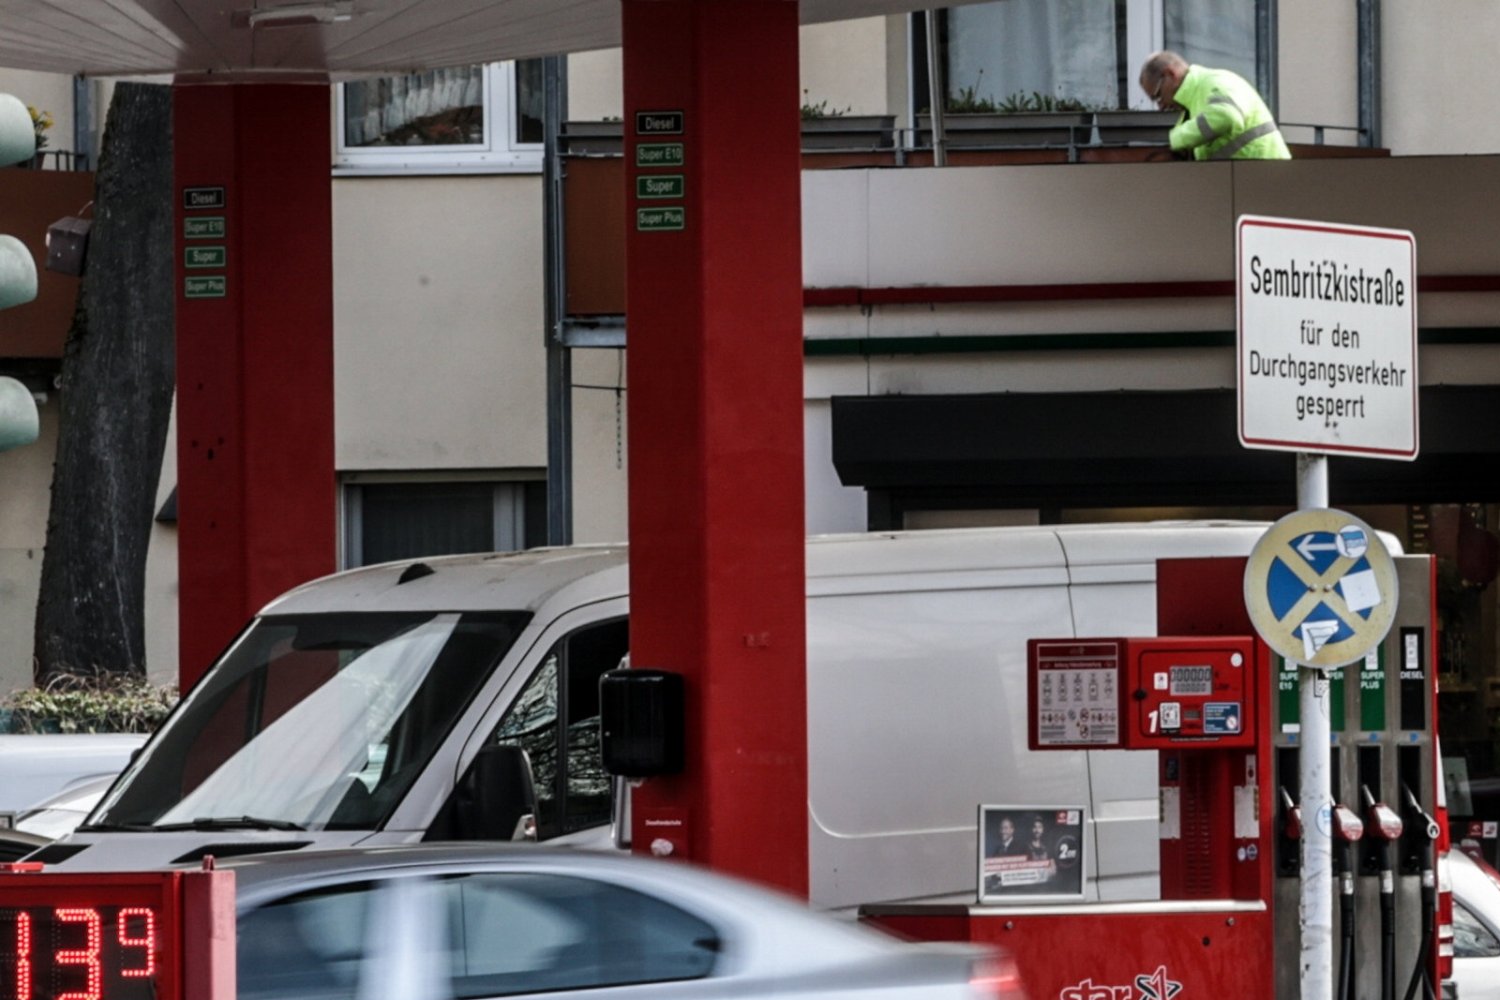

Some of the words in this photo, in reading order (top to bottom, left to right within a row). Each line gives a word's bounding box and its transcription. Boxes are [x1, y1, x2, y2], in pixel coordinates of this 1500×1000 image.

[645, 117, 675, 130] Diesel
[640, 148, 663, 162] Super
[665, 147, 682, 159] E10
[646, 179, 674, 195] Super
[191, 192, 217, 205] Diesel
[640, 212, 663, 226] Super
[664, 211, 682, 223] Plus
[186, 222, 207, 235] Super
[193, 251, 217, 265] Super
[187, 281, 207, 293] Super
[1250, 255, 1405, 307] Sembritzkistraße
[1300, 320, 1324, 346] für
[1332, 322, 1360, 349] den
[1250, 350, 1406, 388] Durchgangsverkehr
[1296, 395, 1365, 421] gesperrt
[1280, 672, 1298, 681] SUPE
[1361, 671, 1385, 680] SUPER
[1400, 671, 1424, 680] DIESEL
[1280, 682, 1293, 690] E10
[1361, 681, 1380, 689] PLUS
[1148, 710, 1158, 733] 1
